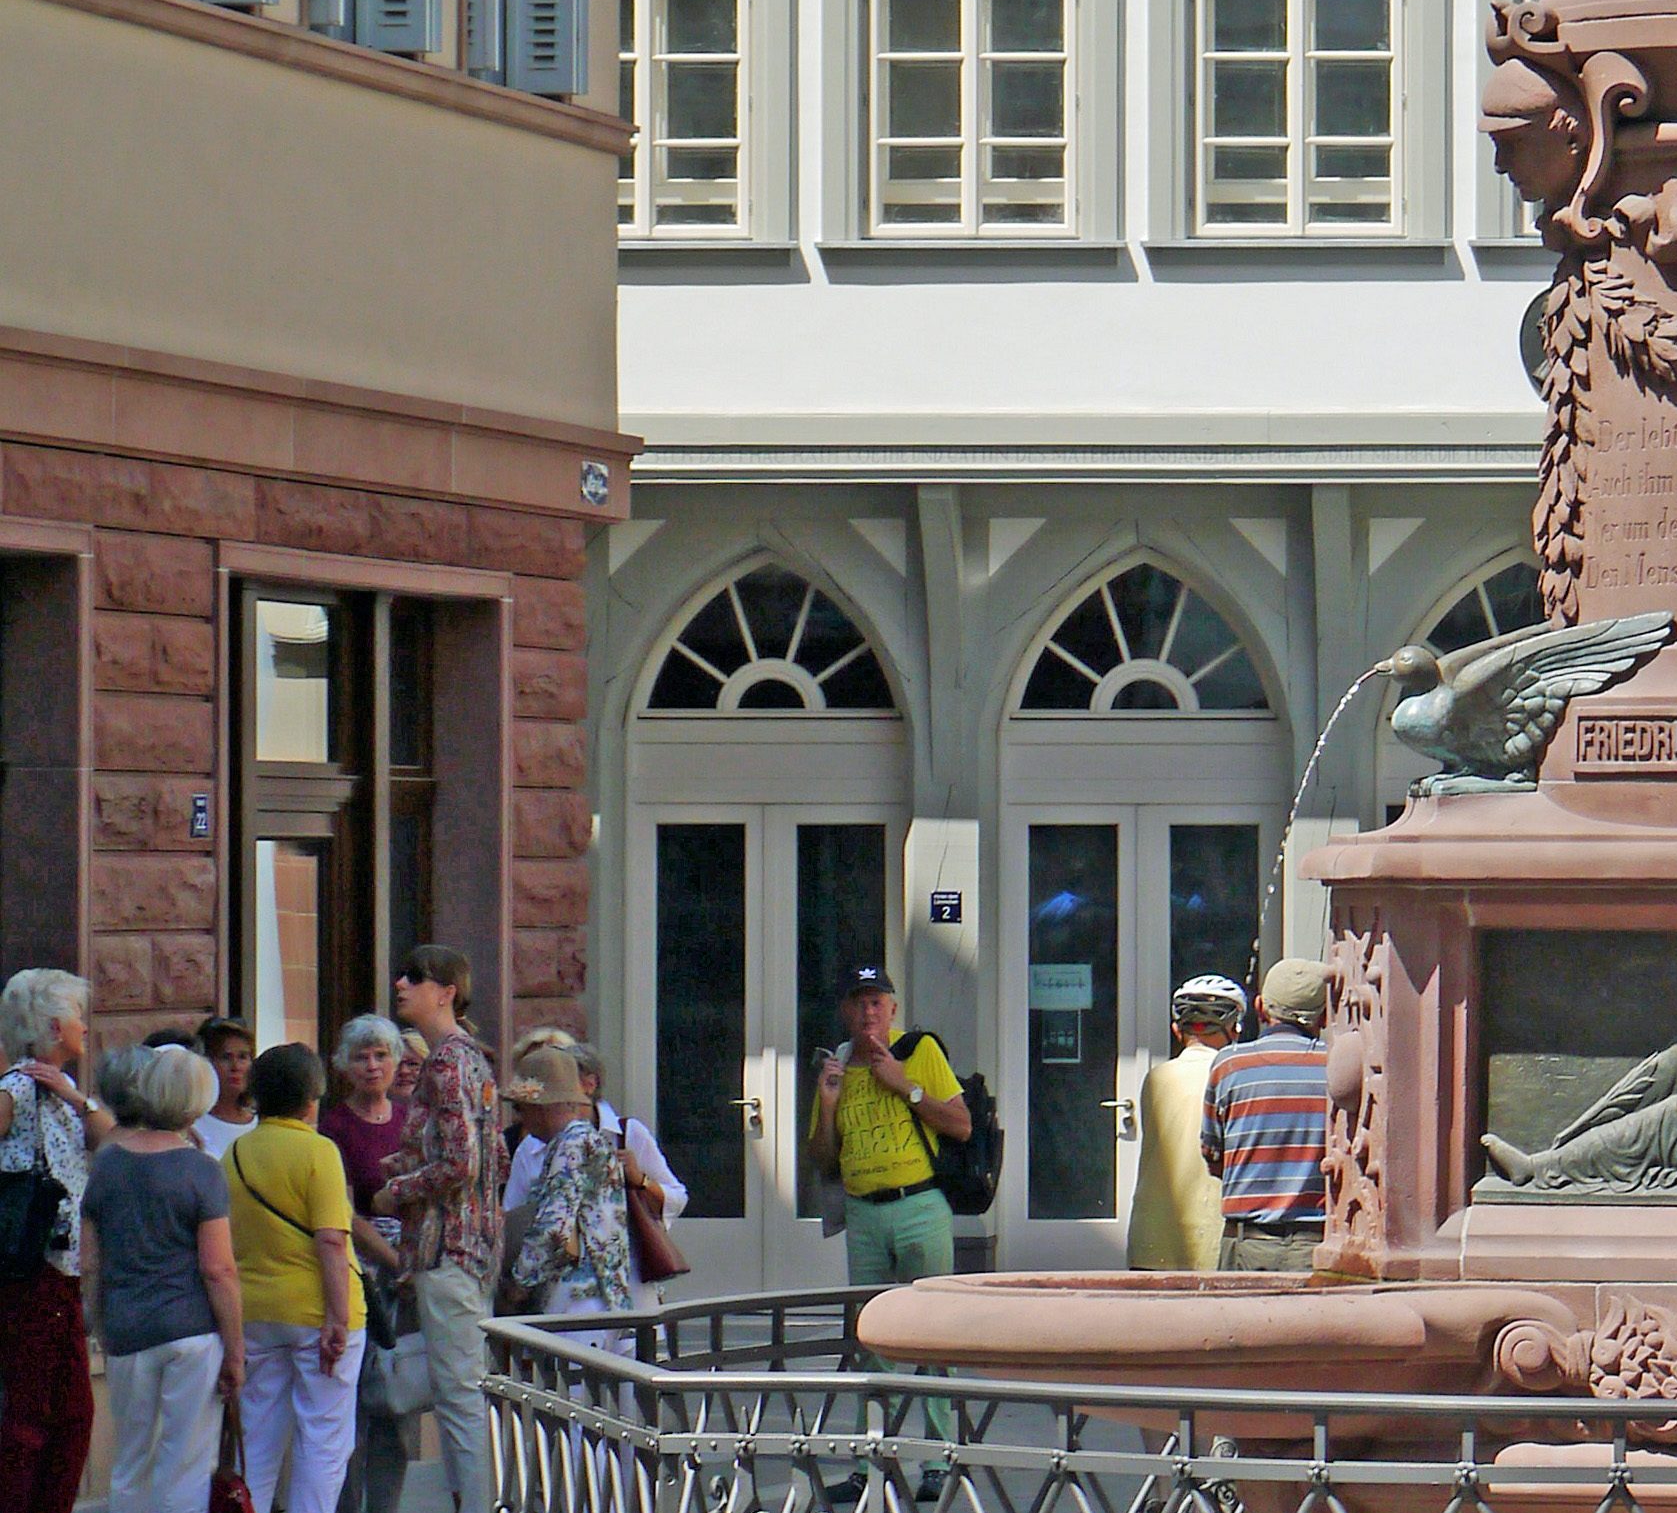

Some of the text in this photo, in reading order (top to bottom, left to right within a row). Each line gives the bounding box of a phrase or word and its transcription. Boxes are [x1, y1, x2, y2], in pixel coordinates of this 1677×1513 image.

[1598, 419, 1636, 454] Der
[1637, 462, 1675, 496] ihm
[1622, 521, 1650, 541] um
[1584, 554, 1620, 589] Den
[942, 906, 951, 920] 2
